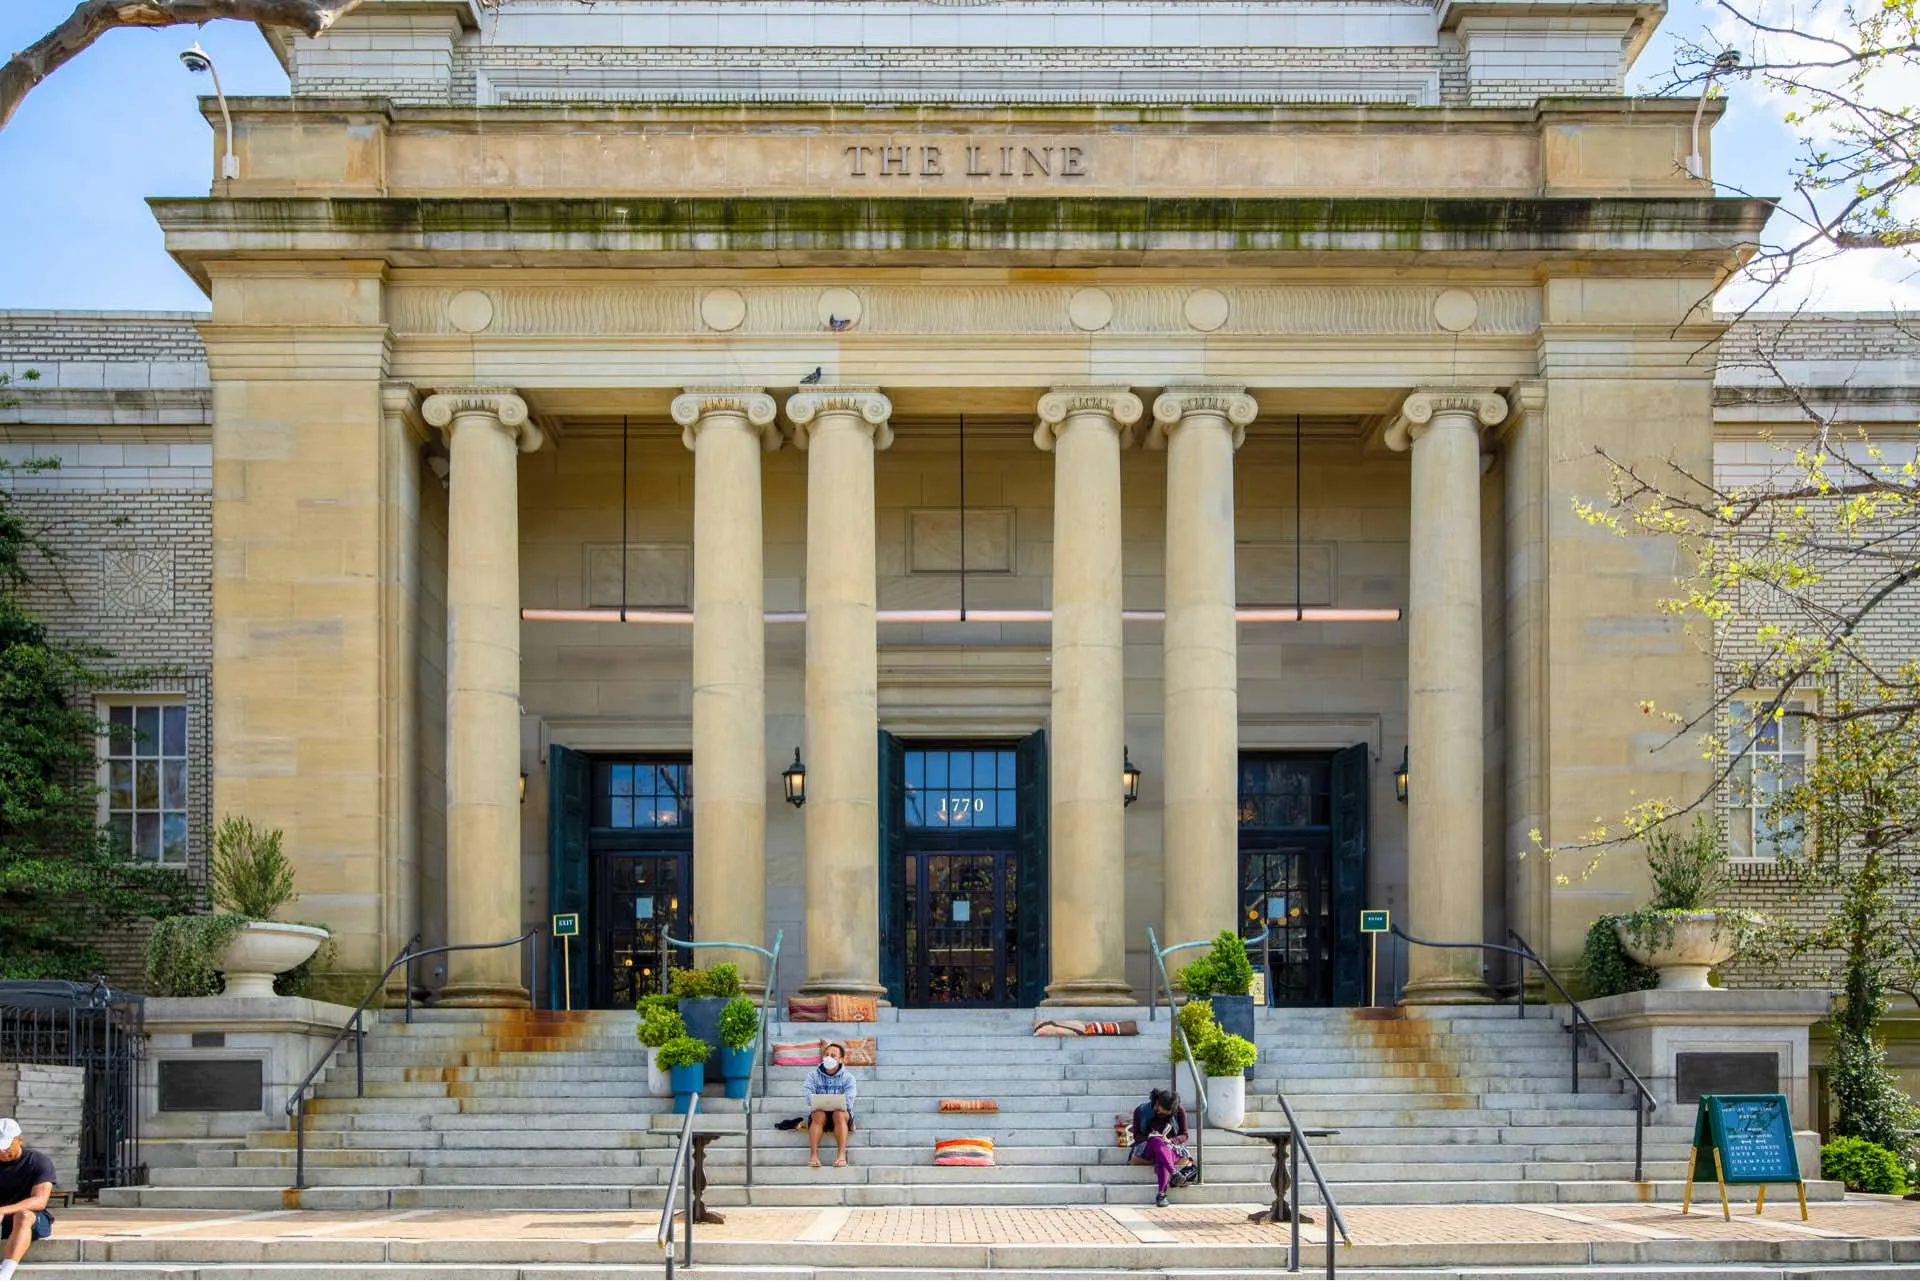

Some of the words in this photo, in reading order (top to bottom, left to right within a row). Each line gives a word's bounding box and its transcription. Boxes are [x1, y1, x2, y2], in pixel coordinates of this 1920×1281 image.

[844, 146, 944, 177] THE
[965, 146, 1087, 177] LINE
[940, 797, 985, 813] 1770
[558, 919, 574, 927] EXIT
